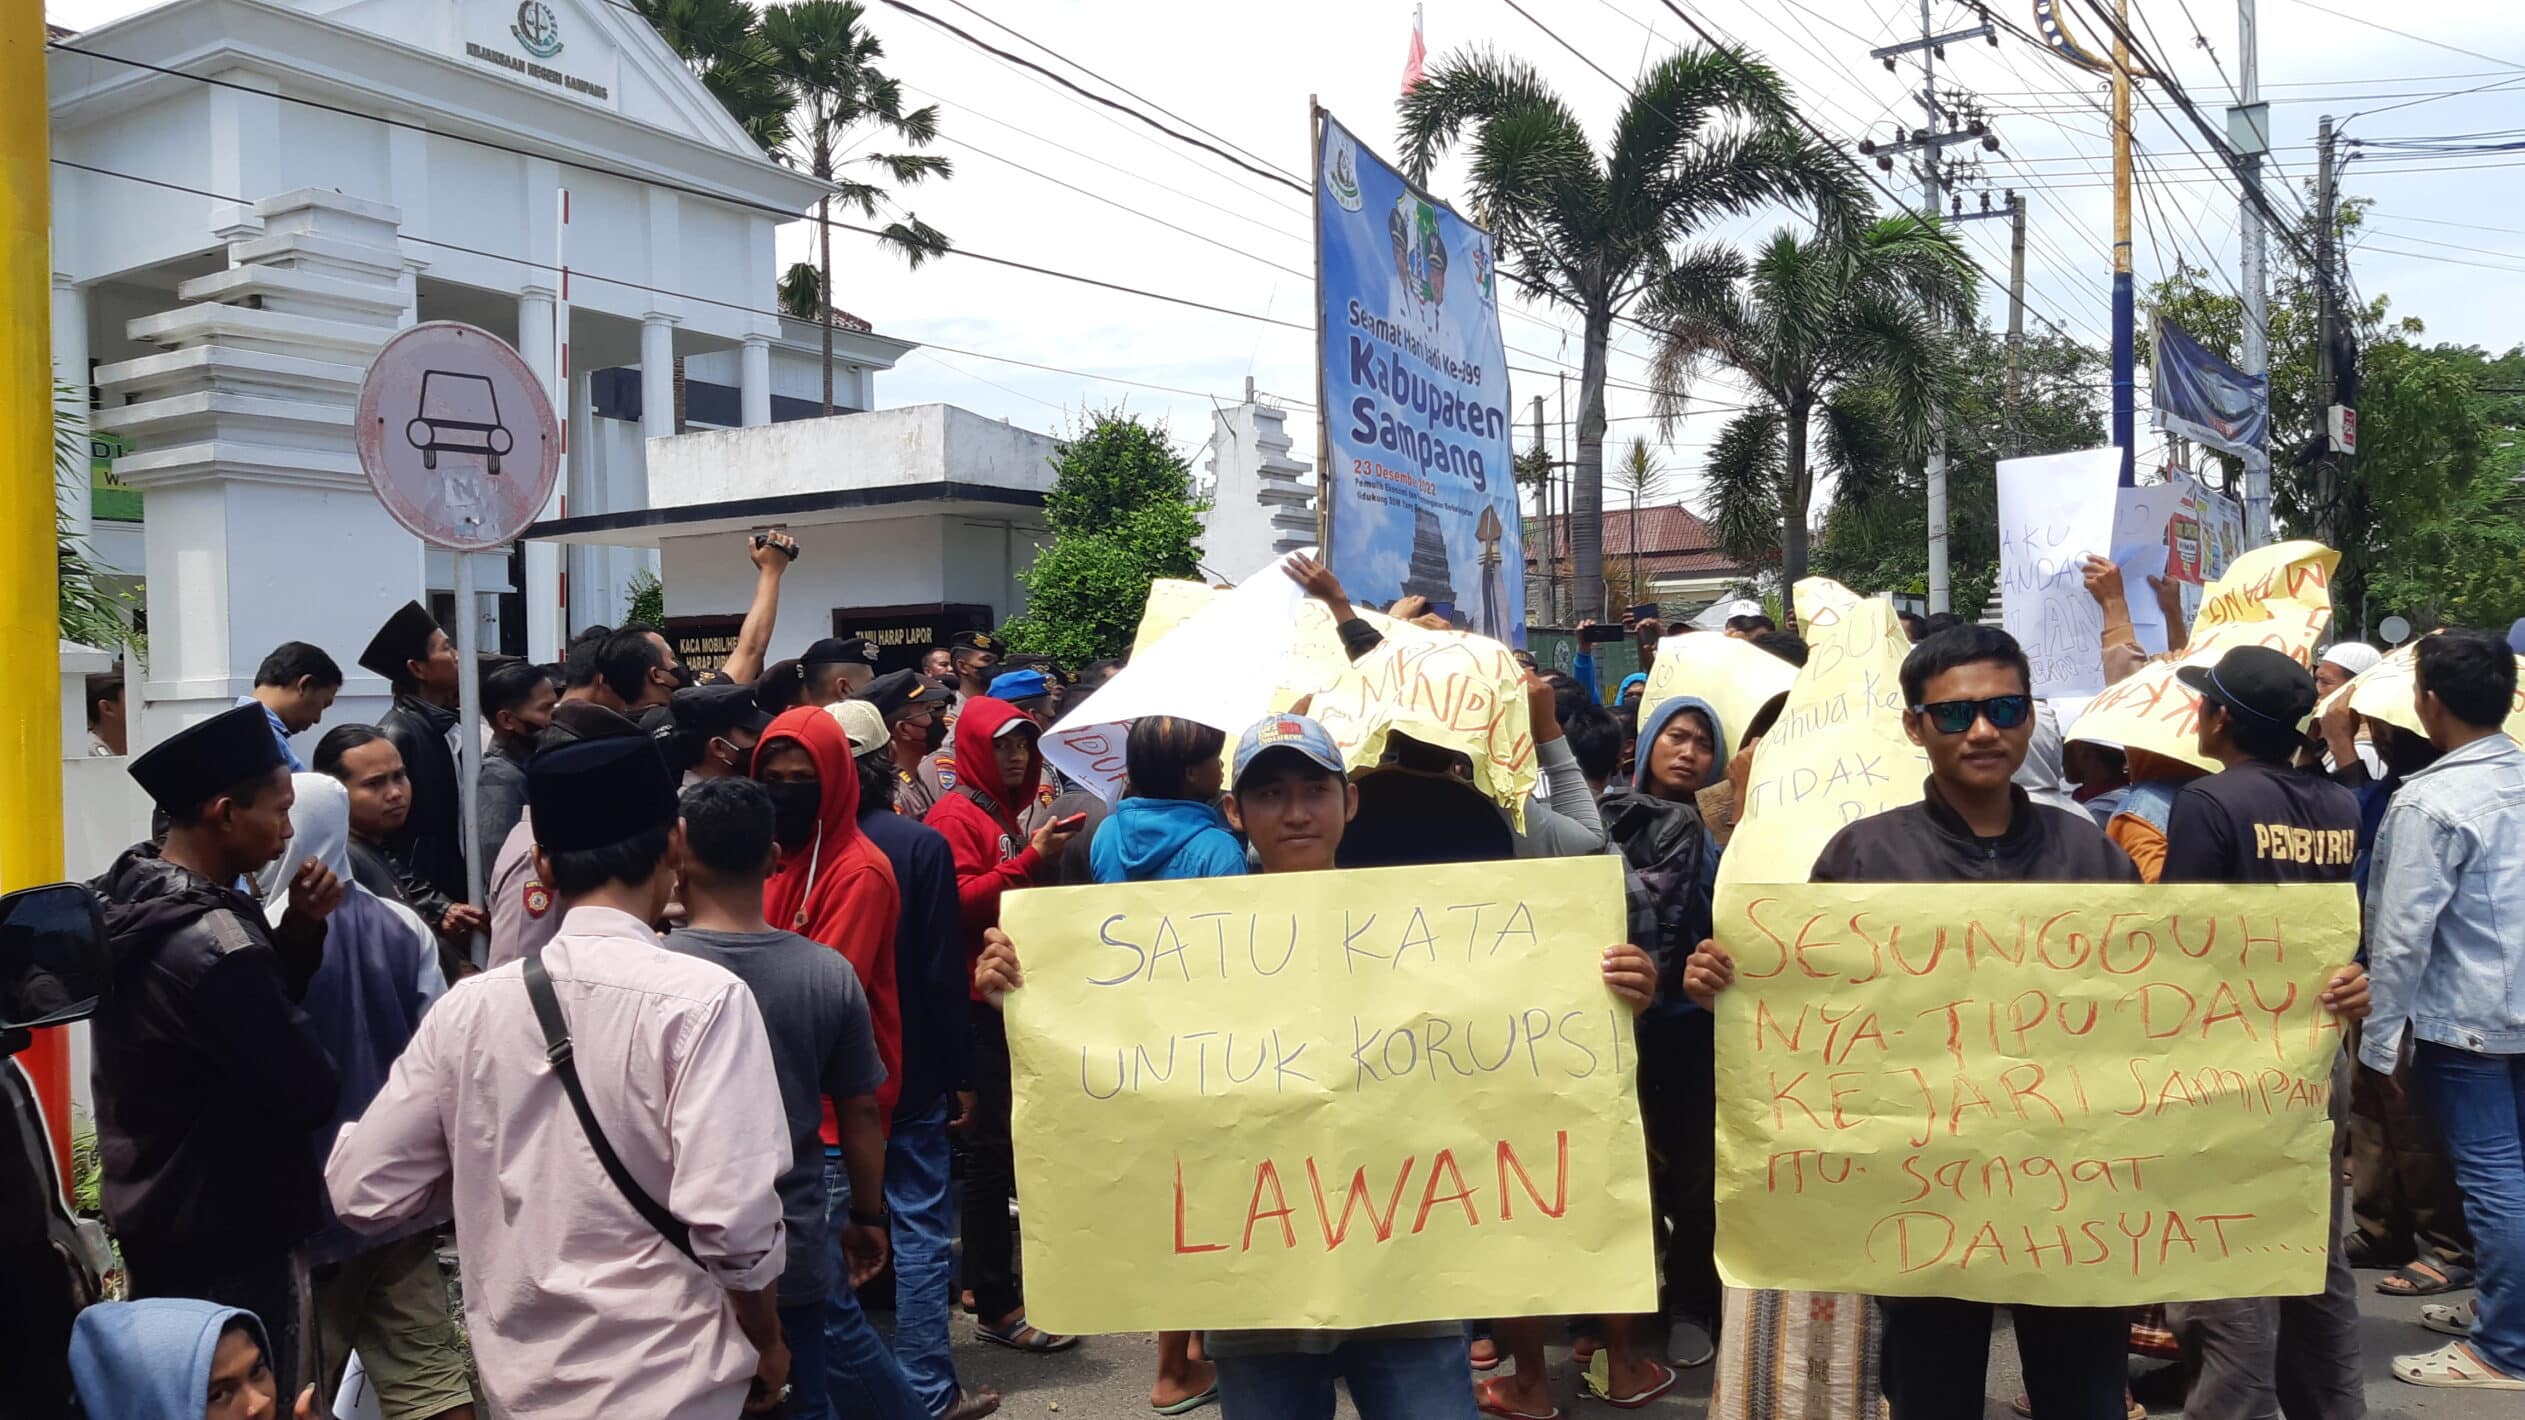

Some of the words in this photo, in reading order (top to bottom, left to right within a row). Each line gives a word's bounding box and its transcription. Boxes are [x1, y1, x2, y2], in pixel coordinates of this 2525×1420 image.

[1350, 335, 1504, 441] Kabupaten
[1351, 397, 1487, 493] Sampang
[1354, 459, 1372, 475] 23
[2001, 523, 2071, 558] AKU
[680, 638, 701, 653] KACA
[686, 655, 712, 671] HARAP
[878, 629, 904, 645] HARAP
[906, 627, 932, 644] LAPOR
[1750, 752, 1890, 818] TIDAK
[1086, 913, 1297, 986] SATU
[1343, 902, 1538, 975] KATA
[1742, 897, 2285, 985] SESUNGGUH
[1081, 1028, 1315, 1100] UNTUK
[1352, 1007, 1622, 1092] KORUPSI
[1916, 990, 2099, 1069] TIPU
[2115, 980, 2344, 1058] DAYA
[1768, 1062, 2090, 1148] KEJARI
[1174, 1129, 1568, 1255] LAWAN
